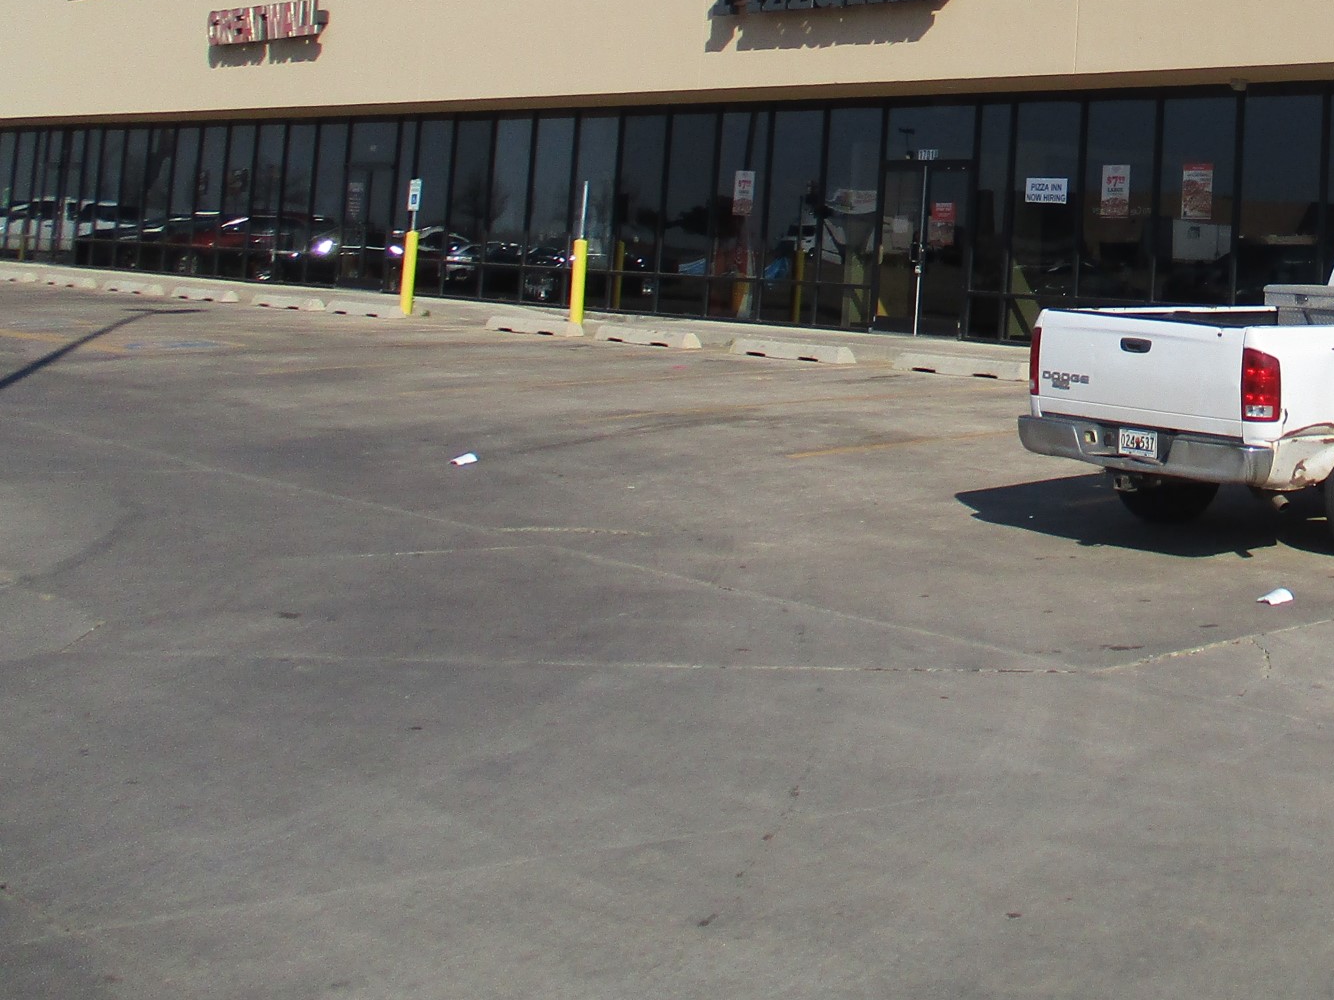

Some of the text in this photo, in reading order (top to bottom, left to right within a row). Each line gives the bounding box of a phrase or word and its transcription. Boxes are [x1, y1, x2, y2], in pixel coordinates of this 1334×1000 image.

[207, 5, 267, 46] GREAT
[1031, 183, 1049, 191] PIZZA
[1043, 194, 1066, 202] HIRING
[1042, 370, 1090, 385] DODGE
